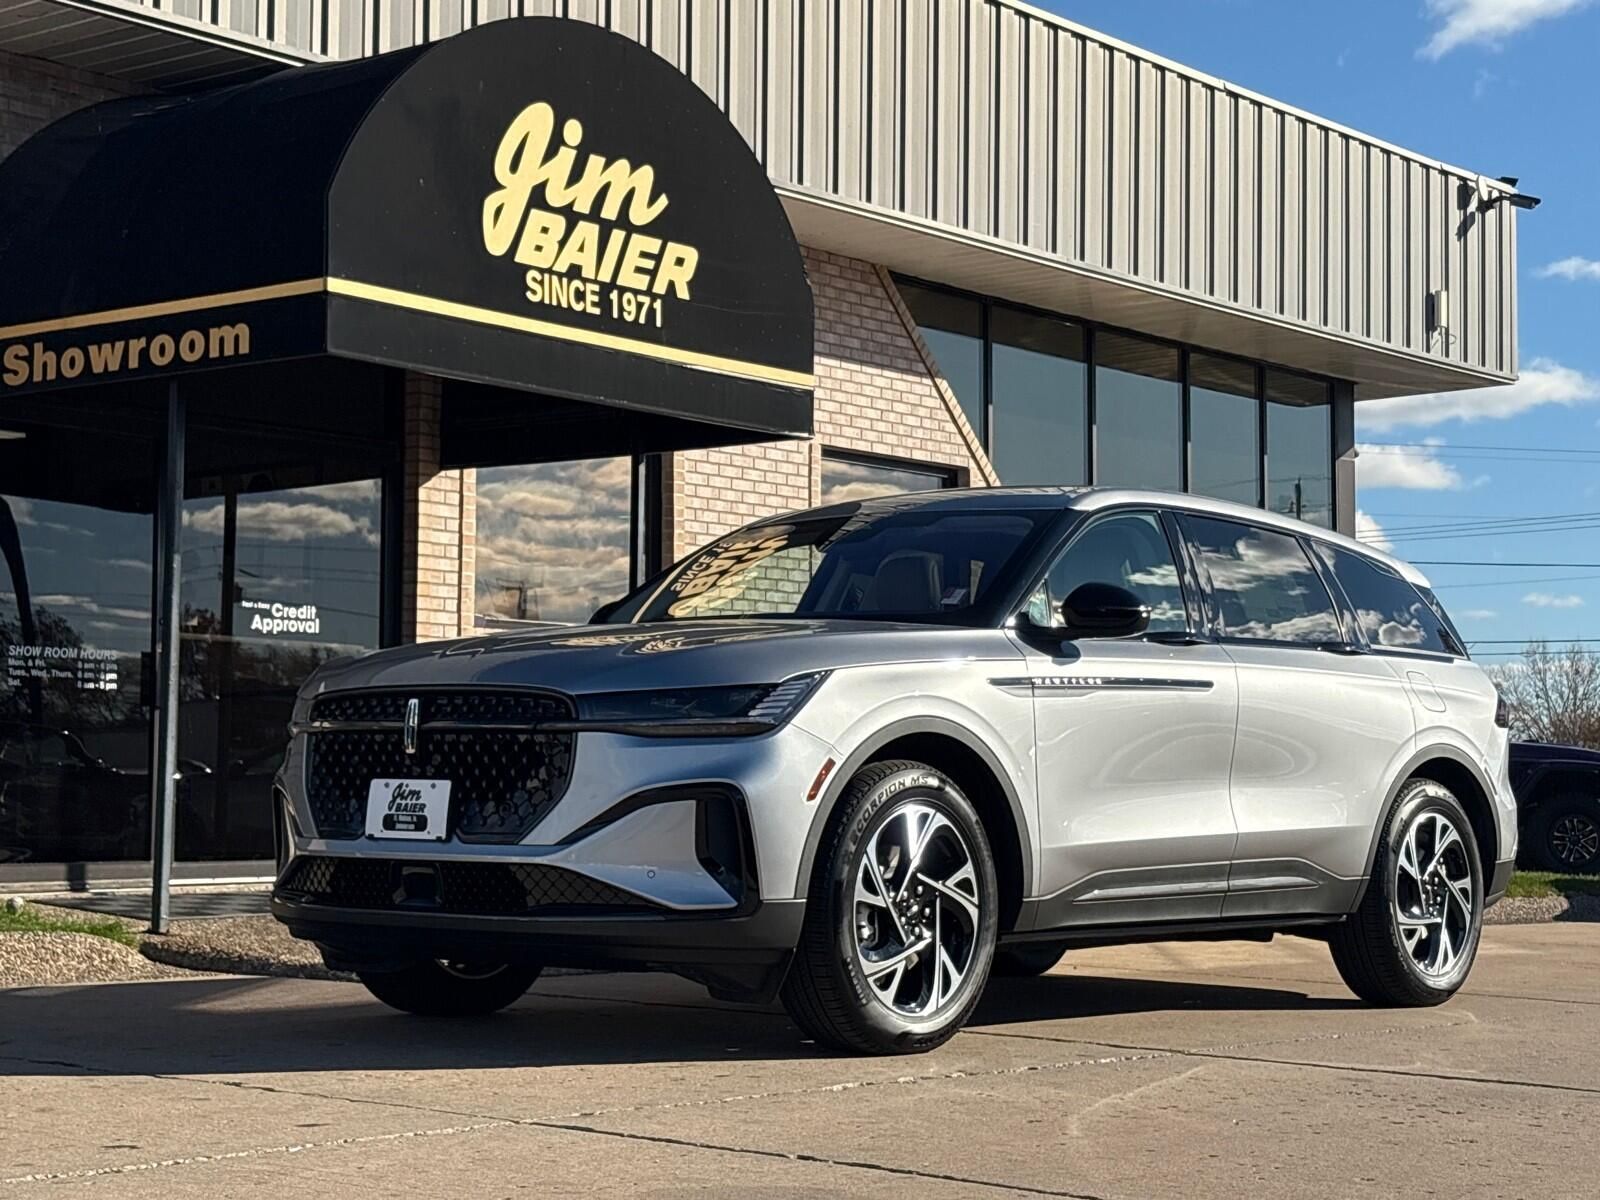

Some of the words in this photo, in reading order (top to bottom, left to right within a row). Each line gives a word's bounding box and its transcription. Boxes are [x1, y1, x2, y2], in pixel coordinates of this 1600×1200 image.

[483, 102, 669, 256] Jim
[514, 208, 699, 301] BAIER
[525, 269, 601, 315] SINCE
[609, 289, 662, 328] 1971
[2, 322, 250, 386] Showroom
[251, 614, 320, 634] Approval
[272, 603, 316, 619] Credit
[8, 645, 42, 656] SHOW
[44, 647, 77, 658] ROOM
[80, 649, 118, 660] HOURS
[388, 782, 422, 812] Jim
[395, 803, 426, 813] BAIER
